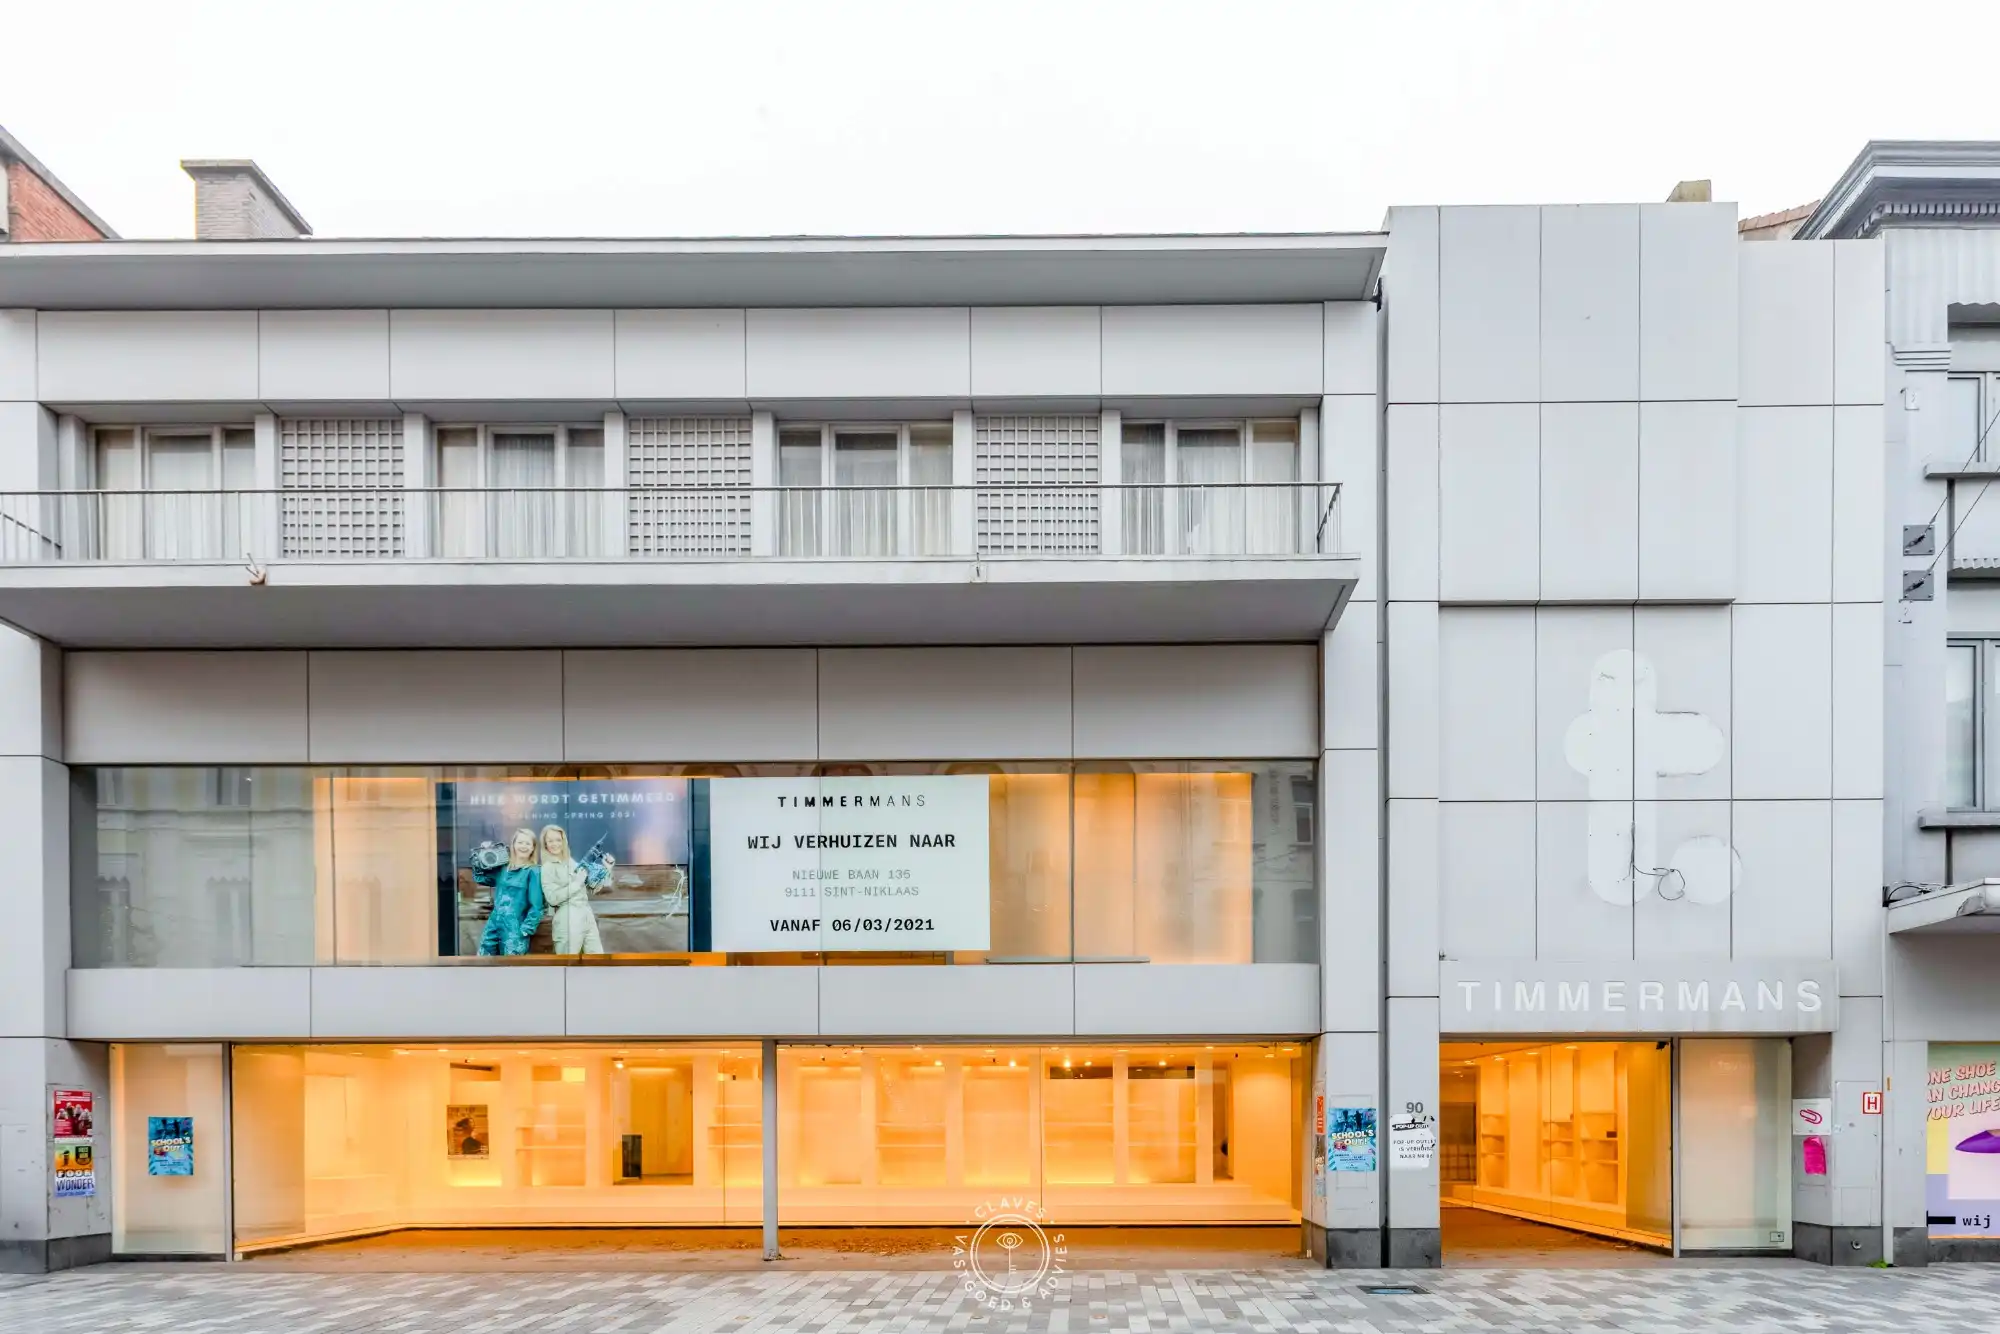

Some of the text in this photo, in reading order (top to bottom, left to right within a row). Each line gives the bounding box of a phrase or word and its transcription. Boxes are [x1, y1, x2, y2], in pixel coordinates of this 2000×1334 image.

[513, 793, 570, 805] WORDT
[777, 794, 926, 808] TIMMERMANS
[747, 834, 956, 849] WIJ VERHUIZEN NAAR
[792, 869, 840, 880] NIEUWE
[848, 869, 880, 880] BAAN
[784, 886, 920, 898] 9111 SINT-NIKLAAS
[770, 918, 935, 932] VANAF 06/03/2021
[1457, 979, 1823, 1013] TIMMERMANS
[1955, 1061, 1996, 1081] SHOE
[1406, 1102, 1424, 1113] 90
[1866, 1096, 1879, 1110] H
[1332, 1130, 1374, 1140] SCHOOL'S
[56, 1178, 95, 1191] WONDER
[1962, 1214, 1991, 1229] wij
